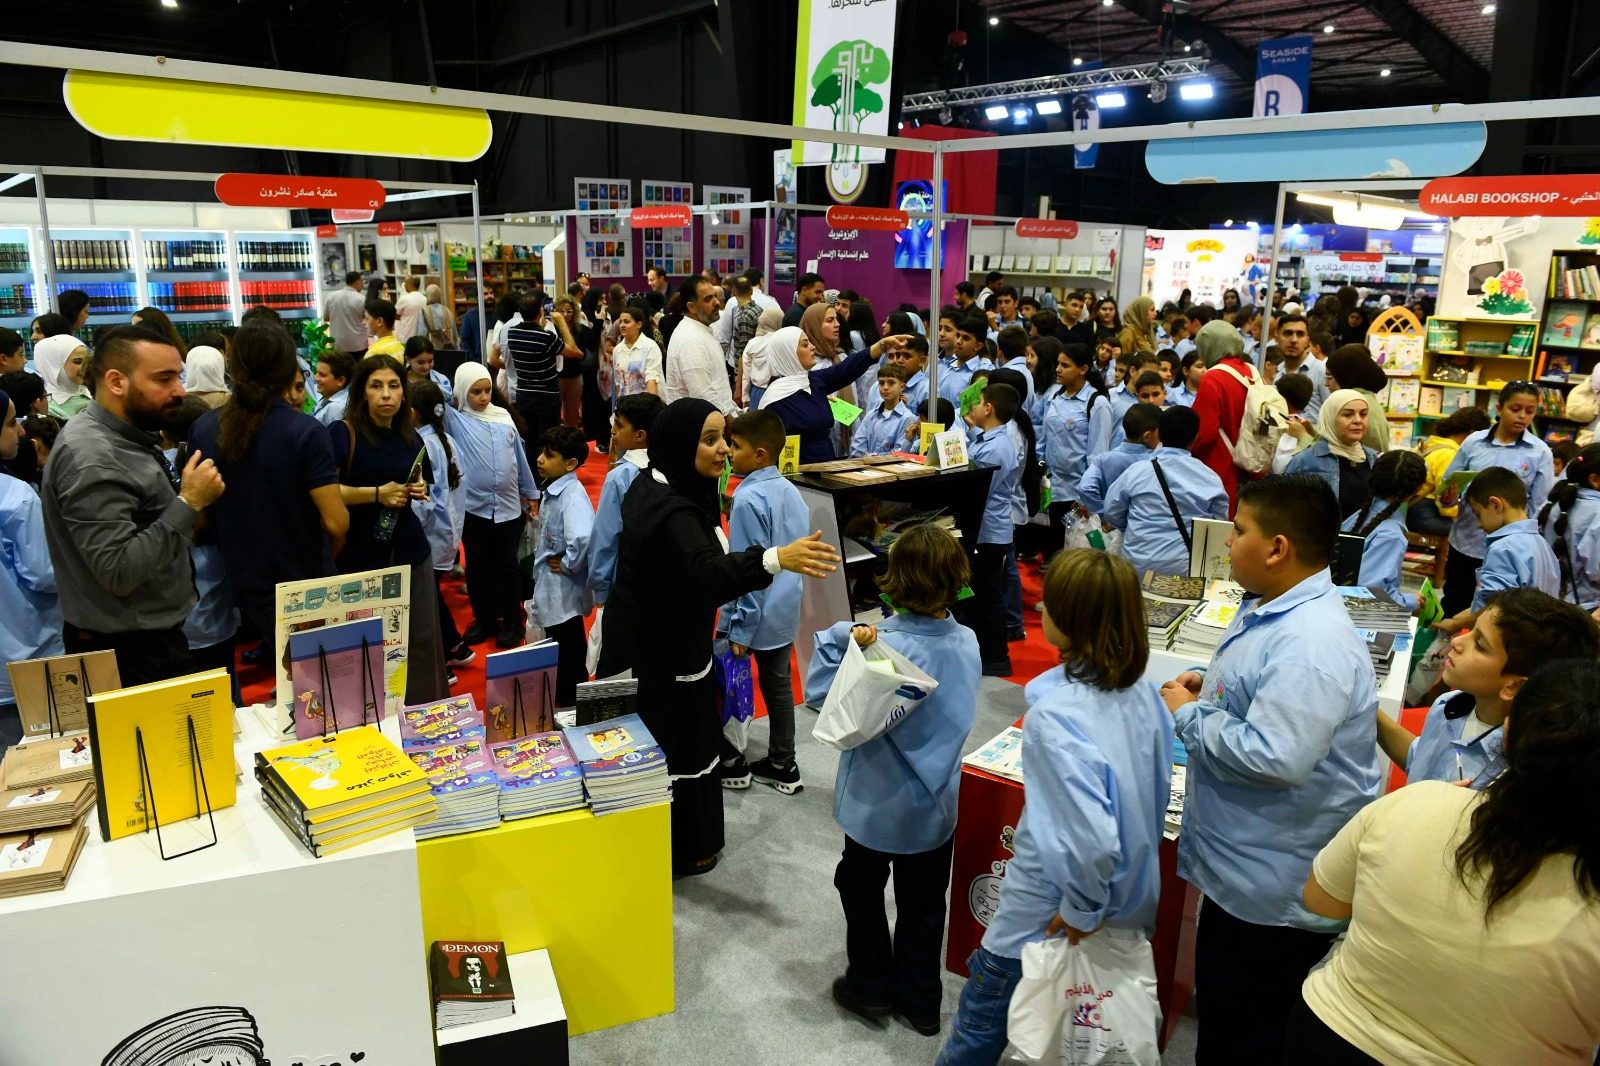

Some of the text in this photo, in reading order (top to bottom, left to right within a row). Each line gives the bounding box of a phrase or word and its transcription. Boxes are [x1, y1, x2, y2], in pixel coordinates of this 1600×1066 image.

[1261, 46, 1309, 59] SEASIDE
[259, 186, 338, 198] مكتبة صادر ناشرون
[1430, 193, 1478, 204] HALABI
[1481, 192, 1560, 204] BOOKSHOP
[817, 249, 869, 262] علم إنسانية الإنسان
[445, 943, 499, 953] DEMON
